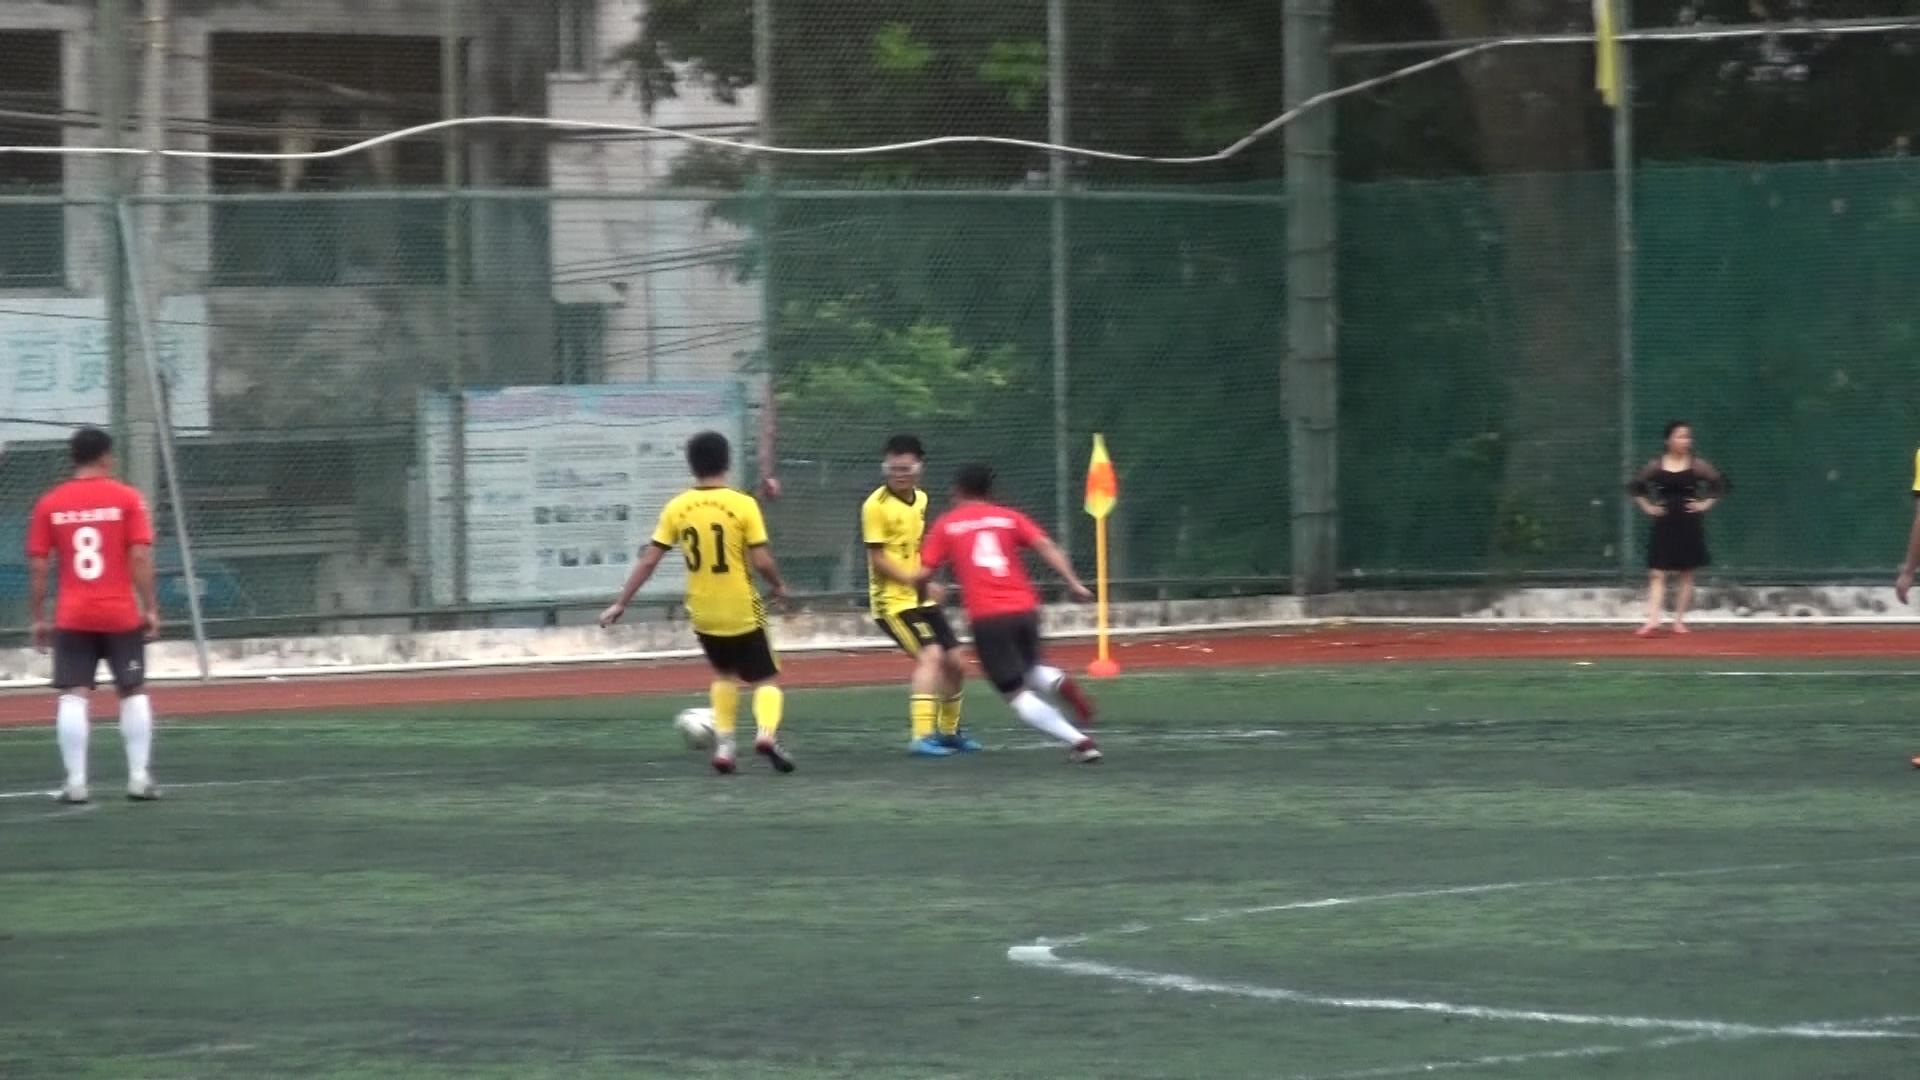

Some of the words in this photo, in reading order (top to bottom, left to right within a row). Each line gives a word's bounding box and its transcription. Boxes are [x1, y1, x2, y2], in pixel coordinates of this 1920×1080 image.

[72, 526, 104, 580] 8
[681, 522, 730, 574] 31
[971, 530, 1011, 578] 4
